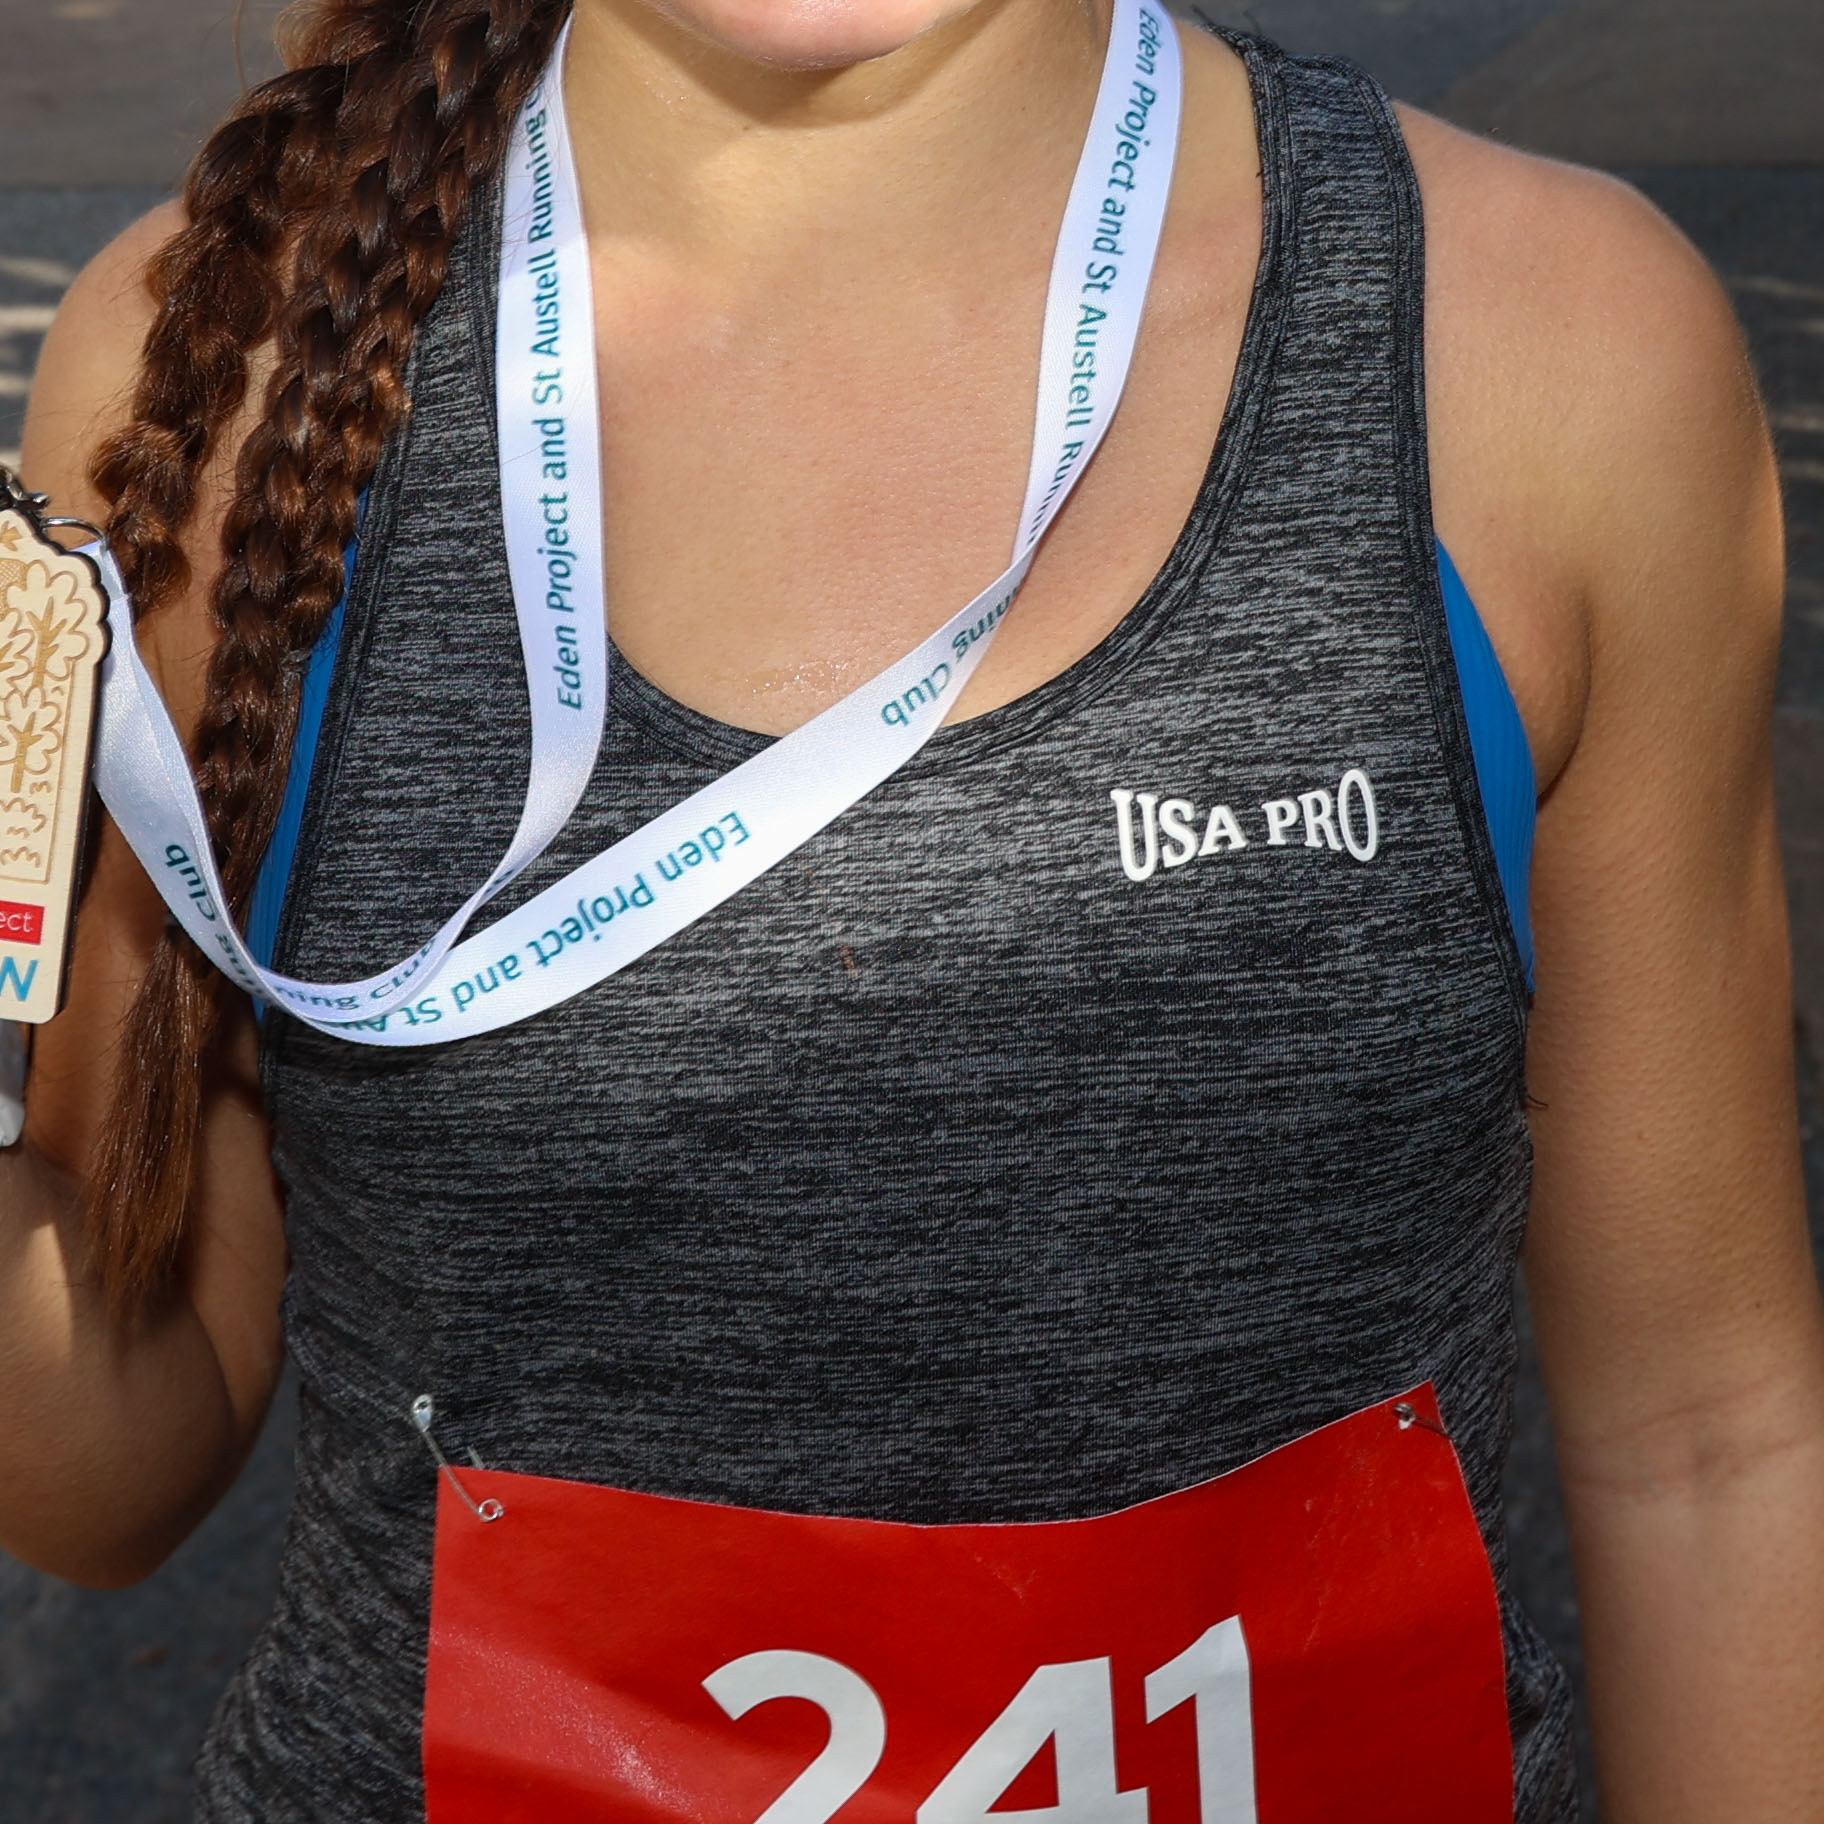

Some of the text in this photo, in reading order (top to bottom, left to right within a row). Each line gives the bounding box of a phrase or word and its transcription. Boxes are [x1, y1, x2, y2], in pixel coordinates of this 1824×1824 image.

[1134, 7, 1161, 76] Eden
[525, 109, 555, 243] Running
[1108, 80, 1156, 192] Project
[1092, 198, 1126, 256] and
[529, 248, 561, 357] Austell
[1082, 261, 1118, 294] St
[532, 368, 564, 405] St
[1065, 303, 1108, 430] Austell
[532, 418, 567, 480] and
[536, 492, 577, 613] Project
[553, 623, 582, 711] Eden
[881, 663, 951, 726] Club
[1110, 769, 1379, 882] USA PRO
[165, 844, 217, 922] Club
[398, 811, 752, 1026] Eden Project and St
[699, 1613, 1260, 1824] 241
